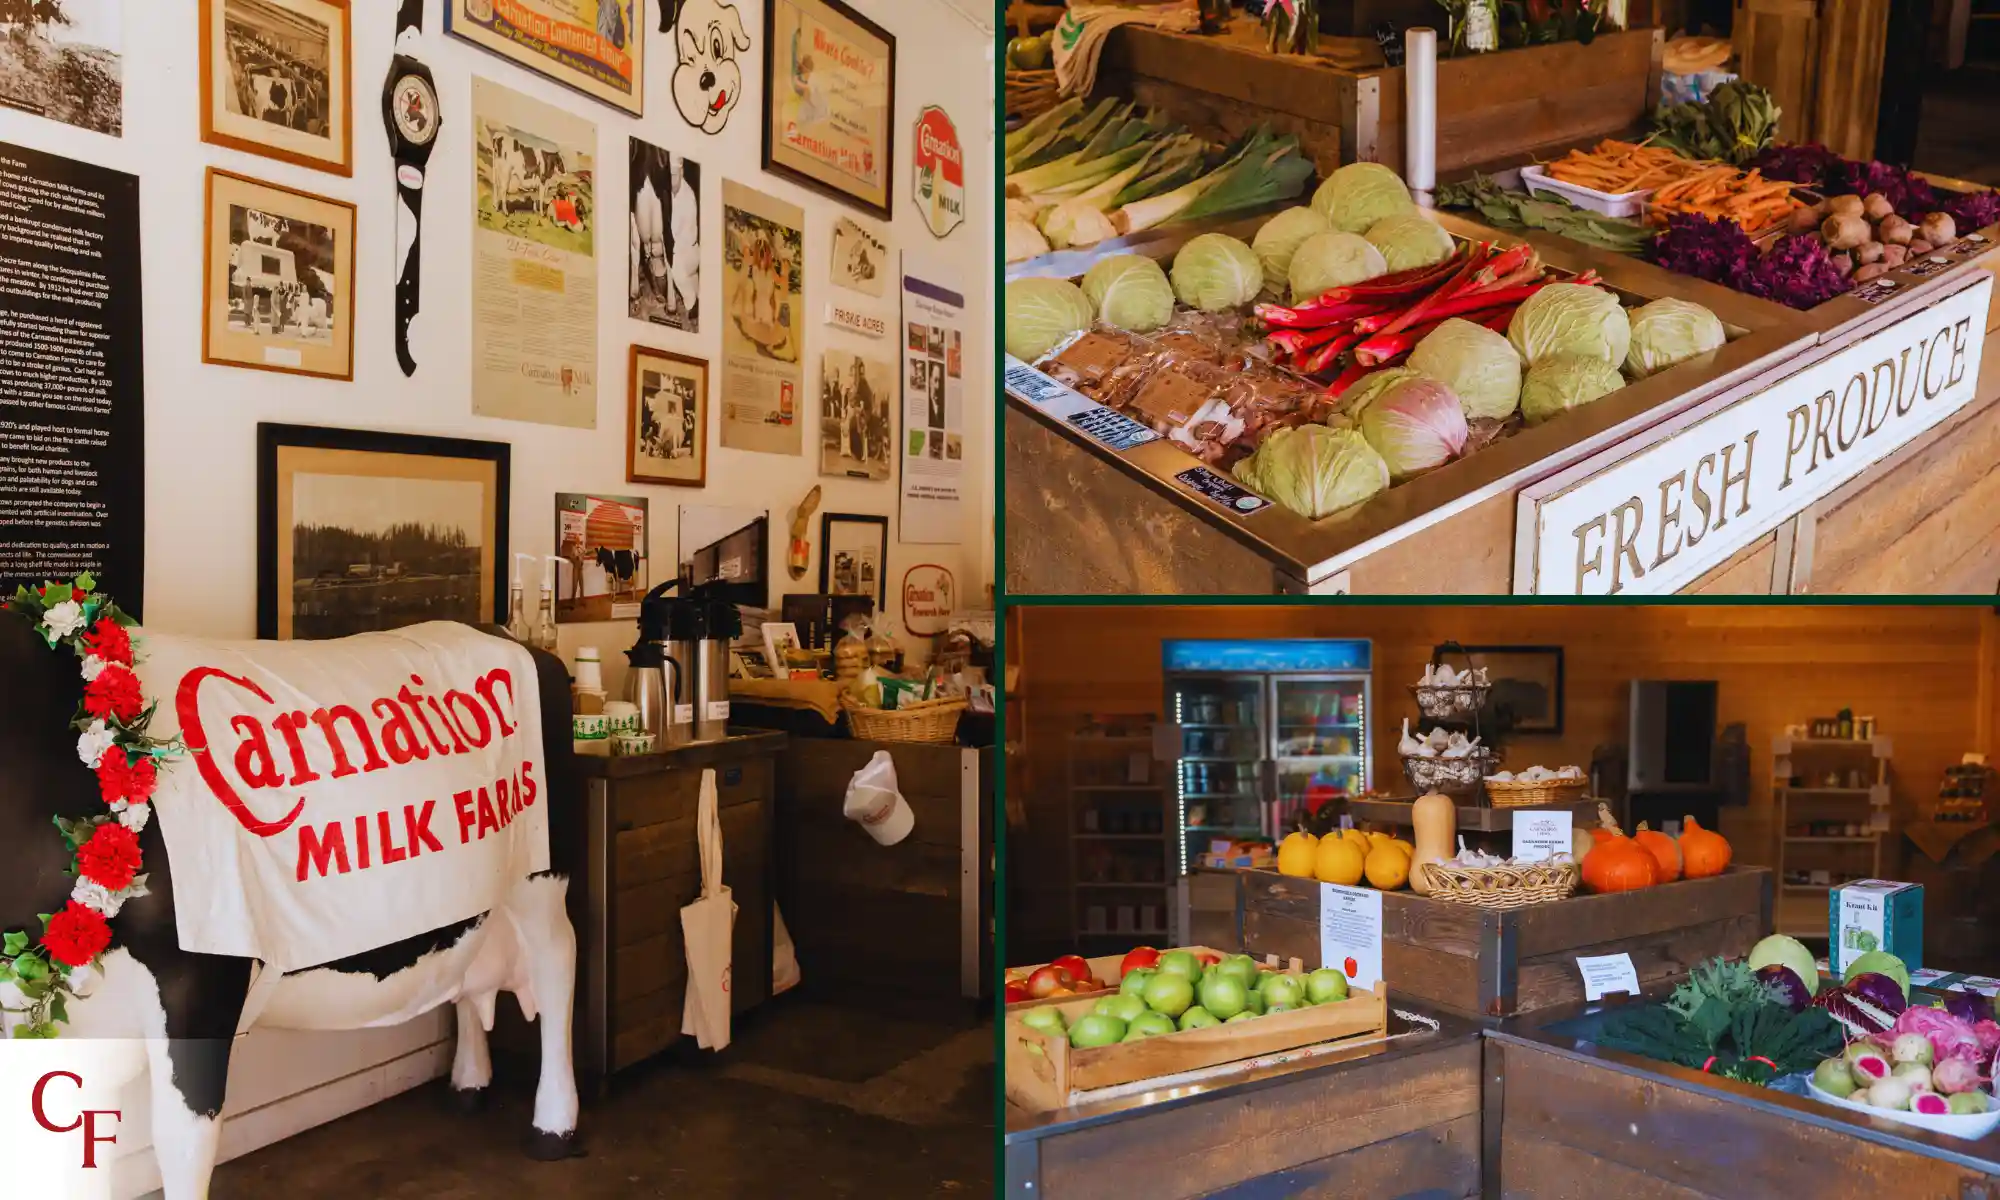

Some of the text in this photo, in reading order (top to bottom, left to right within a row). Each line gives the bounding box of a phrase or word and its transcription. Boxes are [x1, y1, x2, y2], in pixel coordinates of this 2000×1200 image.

[921, 124, 960, 165] Carnation
[0, 156, 27, 168] the Farm
[3, 171, 20, 180] home
[18, 186, 39, 196] grazing
[40, 189, 49, 197] the
[11, 192, 26, 203] being
[939, 193, 961, 216] MILK
[7, 224, 40, 236] background
[9, 234, 78, 255] improve quality breeding
[18, 259, 91, 277] farm along the Snoqualmie
[47, 283, 61, 291] 1912
[50, 275, 109, 290] continued purchase
[6, 287, 41, 299] outbuildings
[75, 299, 101, 310] producing
[19, 313, 48, 321] purchased
[834, 308, 885, 334] FRISKIE ACRES
[17, 321, 37, 329] started
[39, 324, 63, 335] breeding
[20, 330, 30, 338] the
[31, 332, 59, 342] Carnation
[5, 340, 32, 348] produced
[34, 342, 63, 352] 1500-1900
[33, 352, 60, 361] Carnation
[27, 361, 44, 369] stroke
[40, 372, 58, 380] higher
[14, 380, 43, 389] producing
[23, 390, 40, 398] statue
[66, 404, 93, 412] Carnation
[31, 424, 51, 433] played
[74, 427, 92, 435] formal
[9, 442, 29, 450] benefit
[11, 456, 34, 464] brought
[1572, 315, 1972, 595] FRESH PRODUCE
[61, 478, 74, 486] dogs
[14, 499, 42, 507] prompted
[86, 501, 101, 509] begin
[15, 561, 27, 569] long
[80, 561, 96, 569] staple
[175, 666, 519, 837] Carnation
[296, 799, 444, 883] MILK
[1845, 901, 1878, 912] Kraut Kit
